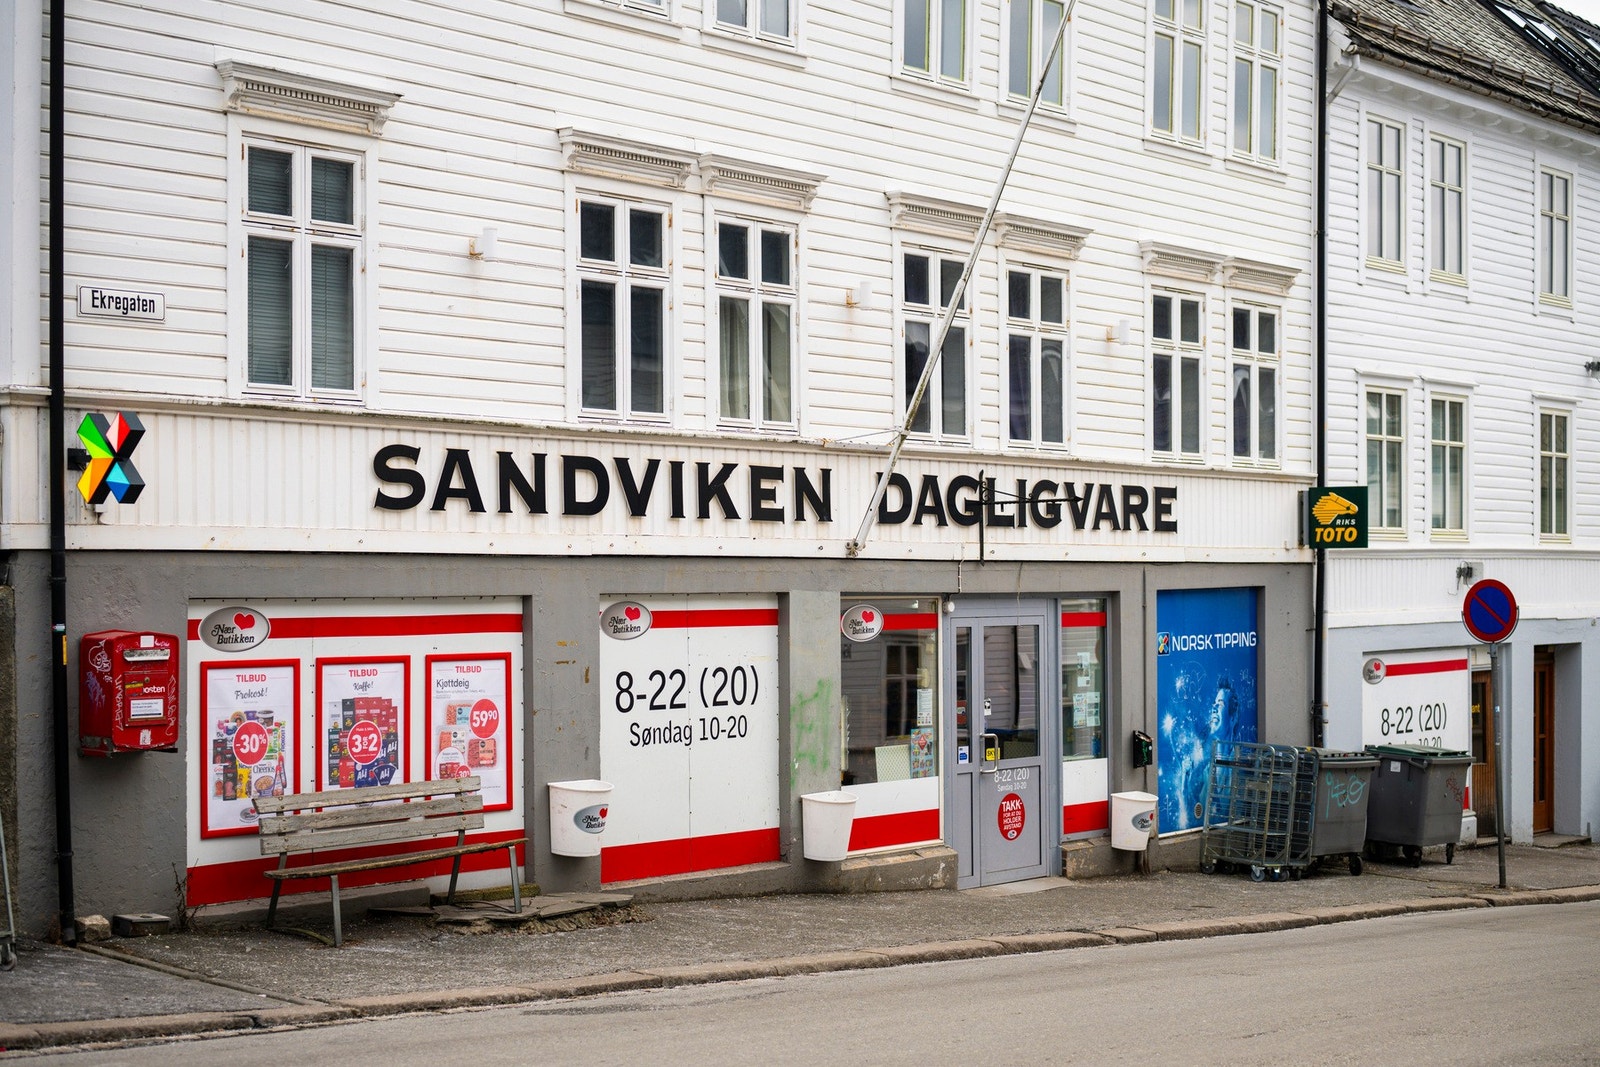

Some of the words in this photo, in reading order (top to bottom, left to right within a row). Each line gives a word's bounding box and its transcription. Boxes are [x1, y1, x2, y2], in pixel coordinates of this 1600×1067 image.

[91, 290, 155, 315] Ekregaten
[373, 443, 833, 524] SANDVIKEN
[876, 471, 1178, 534] DAGLIGVARE
[1315, 527, 1358, 542] TOTO
[608, 616, 627, 628] Nær
[612, 624, 641, 634] Butikken
[210, 623, 236, 637] Nær
[217, 634, 255, 645] Butikken
[1172, 634, 1213, 652] NORSK
[1214, 631, 1257, 649] TIPPING
[349, 669, 378, 677] TILBUD
[455, 665, 482, 673] TILBUD
[236, 674, 267, 683] TILBUD
[436, 678, 470, 689] Kjøttdeig
[615, 669, 687, 714] 8-22
[699, 665, 759, 708] (20)
[1381, 706, 1414, 736] 8-22
[1418, 703, 1447, 732] (20)
[629, 720, 693, 747] Søndag
[699, 714, 748, 741] 10-20
[351, 734, 362, 753] 3
[368, 733, 378, 752] 2
[994, 770, 1012, 783] 8-22
[1013, 768, 1030, 780] (20)
[1003, 816, 1022, 824] HOLDER
